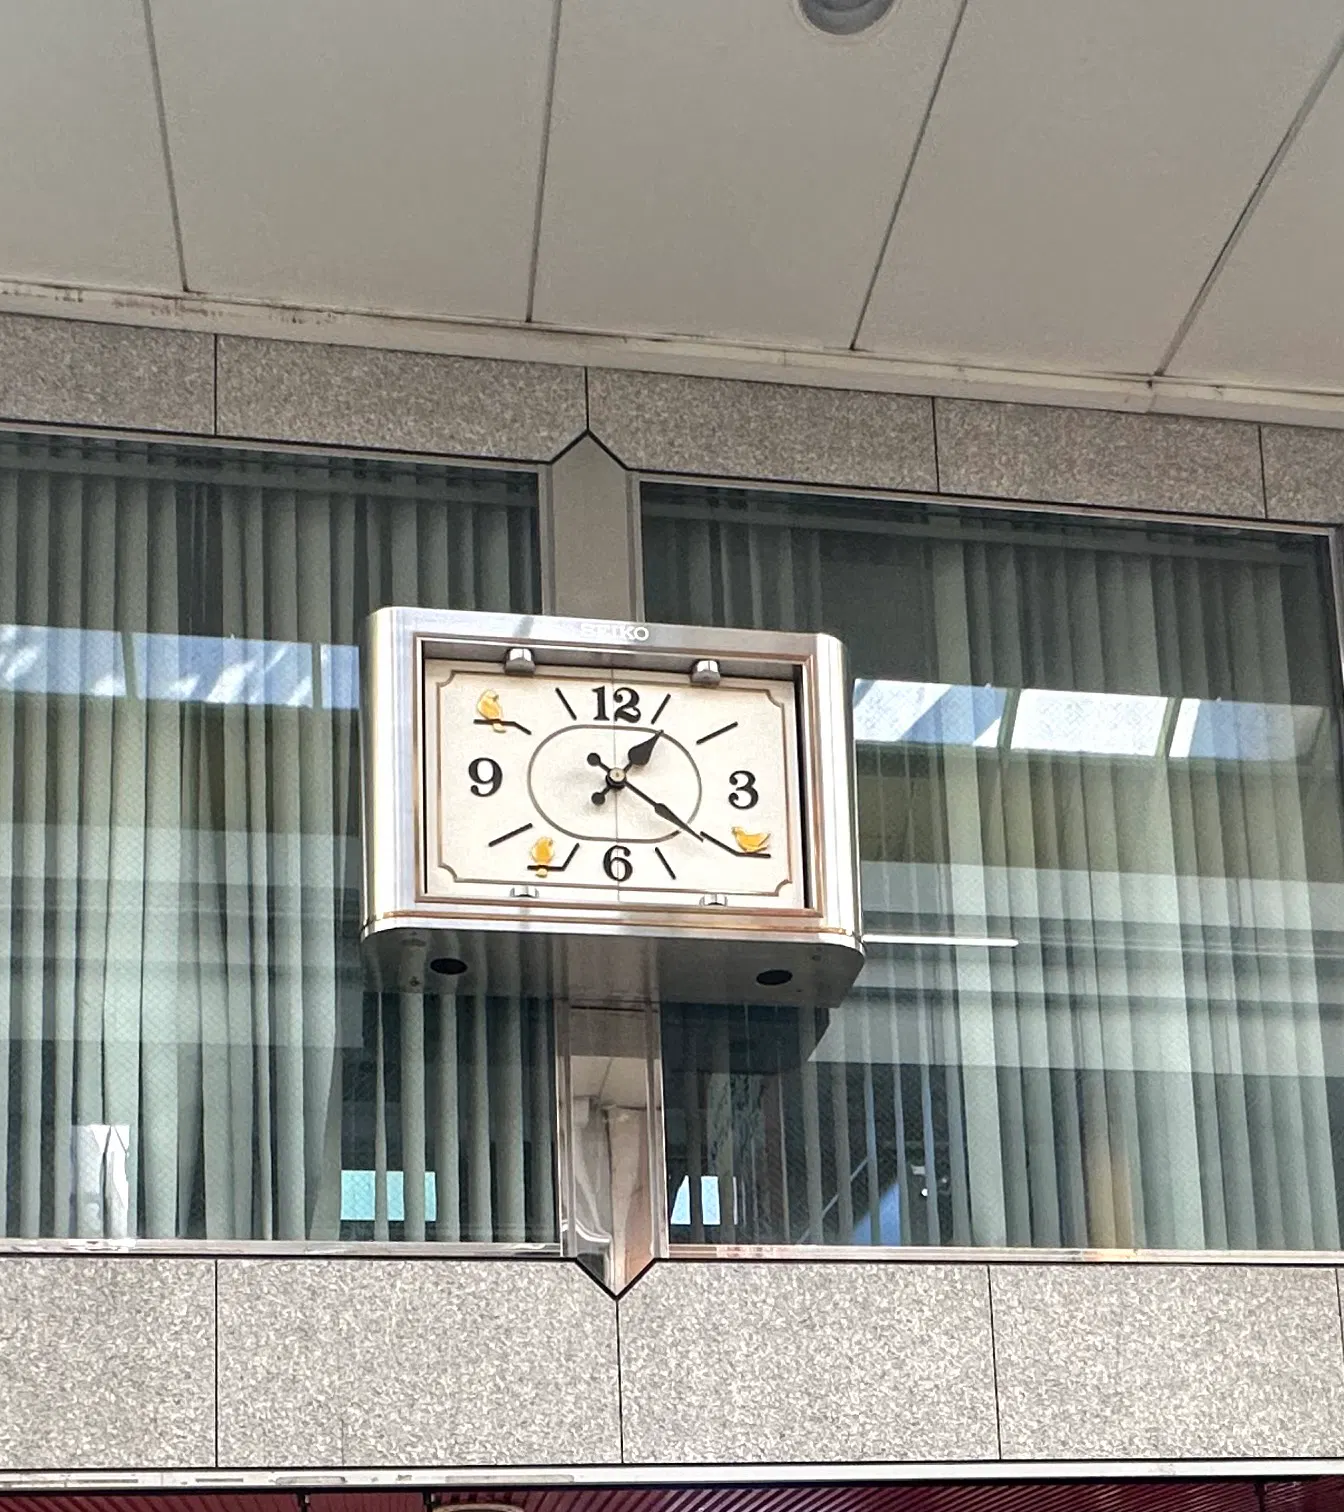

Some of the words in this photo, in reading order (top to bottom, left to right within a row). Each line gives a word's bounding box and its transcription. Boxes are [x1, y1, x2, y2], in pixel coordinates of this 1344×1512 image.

[579, 623, 650, 642] SEIKO
[592, 685, 642, 724] 12
[467, 757, 503, 797] 9
[728, 770, 759, 810] 3
[602, 845, 634, 882] 6
